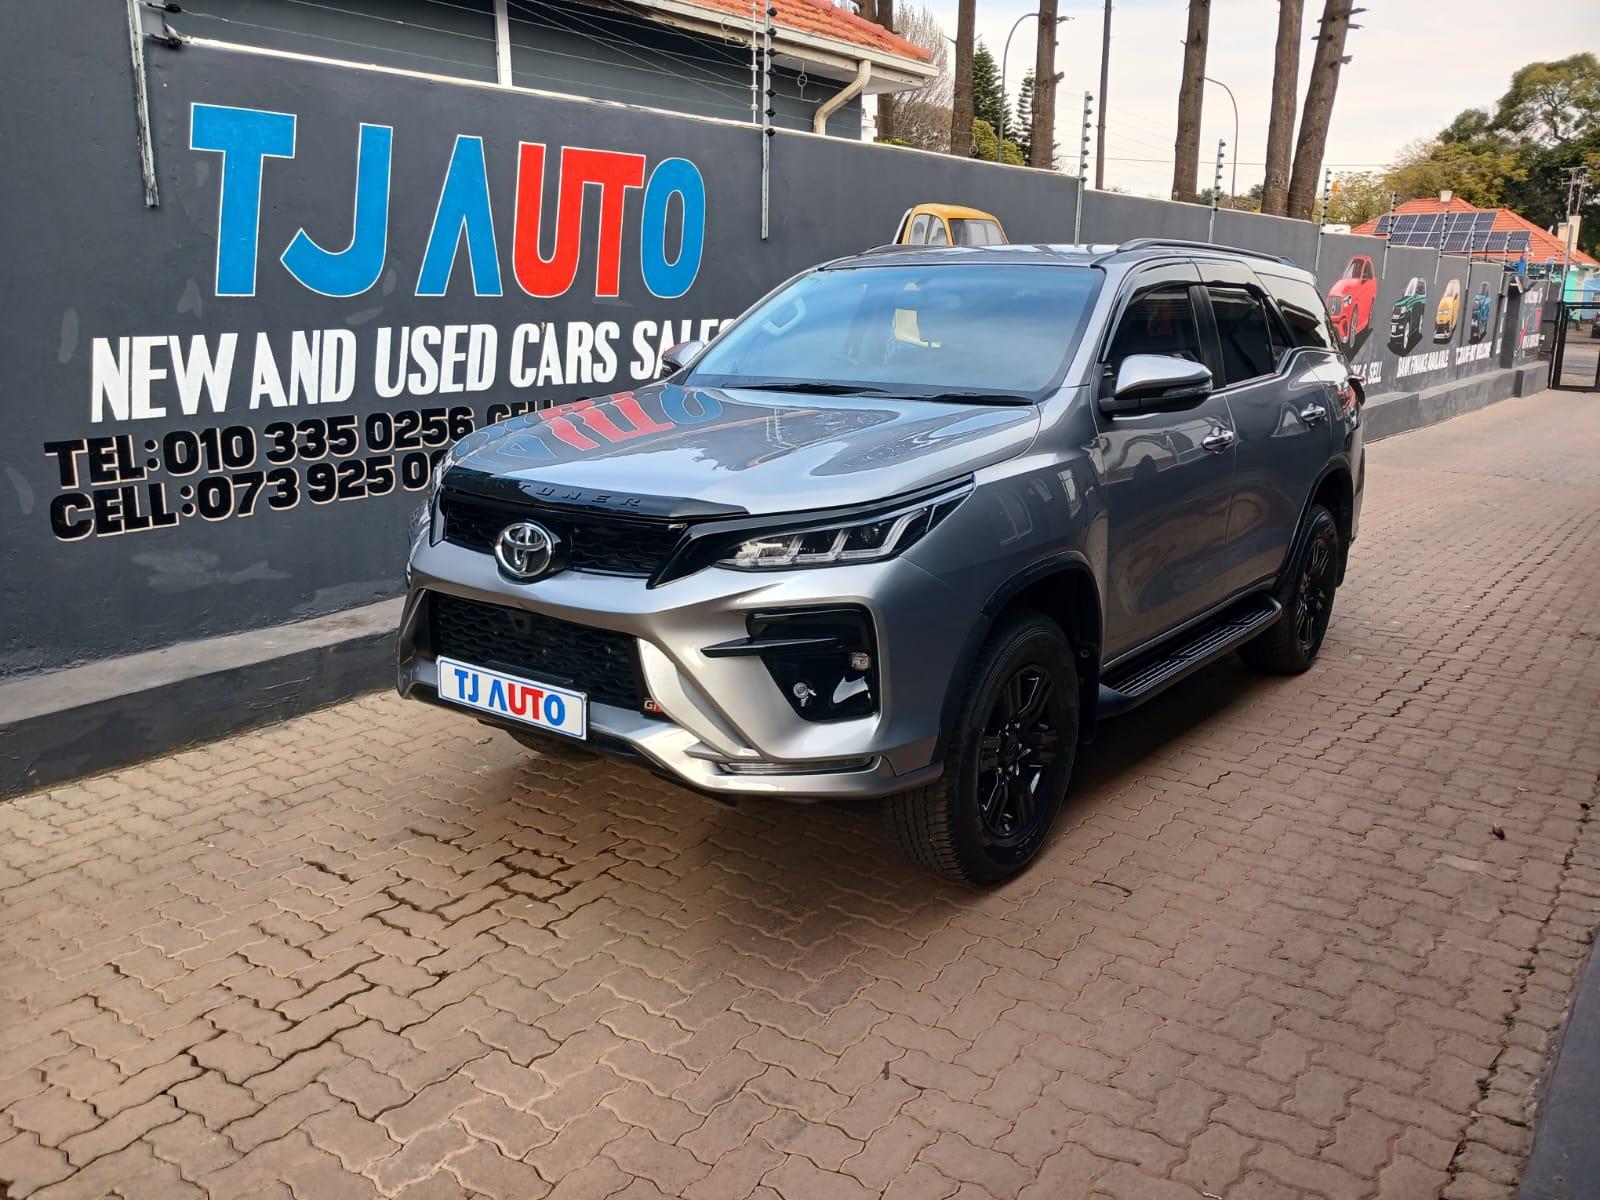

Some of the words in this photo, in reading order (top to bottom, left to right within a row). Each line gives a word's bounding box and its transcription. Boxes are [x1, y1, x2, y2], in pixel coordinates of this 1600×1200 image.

[190, 102, 393, 297] TJ
[415, 134, 706, 298] AUTO
[91, 332, 239, 423] NEW
[249, 329, 356, 409] AND
[374, 323, 499, 396] USED
[508, 320, 620, 388] CARS
[264, 415, 359, 465] 335
[365, 405, 475, 453] 0256
[307, 455, 396, 503] 925
[454, 668, 479, 703] TJ
[488, 679, 565, 726] AUTO
